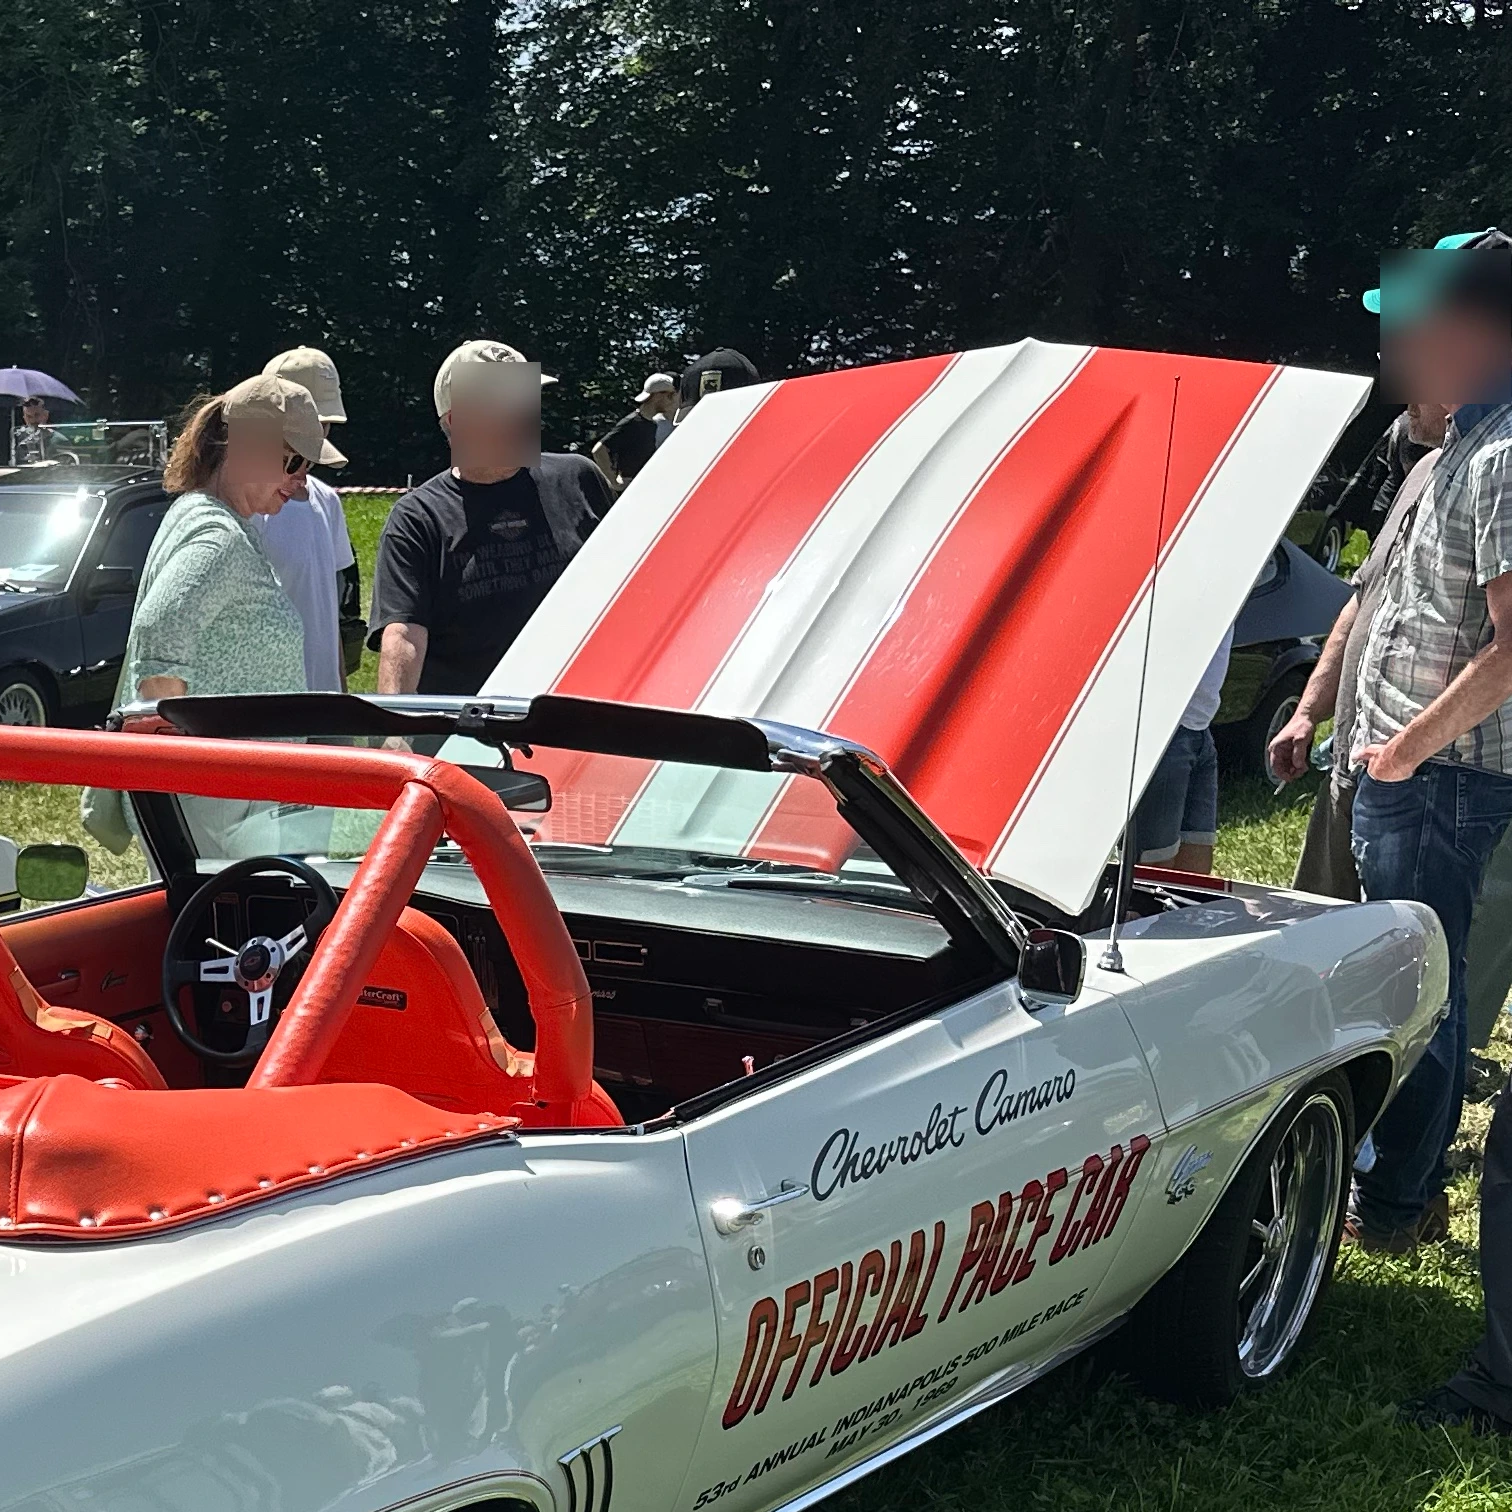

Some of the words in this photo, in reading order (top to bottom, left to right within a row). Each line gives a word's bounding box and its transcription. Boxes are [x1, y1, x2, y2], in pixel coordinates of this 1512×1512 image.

[361, 989, 400, 1001] terCraft
[811, 1103, 968, 1201] Chevrolet
[975, 1069, 1076, 1136] Camaro
[722, 1220, 946, 1431] OFFICIAL
[937, 1167, 1069, 1324] PACE
[1049, 1134, 1151, 1266] CAR
[693, 1474, 742, 1511] 53rd
[743, 1426, 828, 1485] ANNUAL
[831, 1354, 963, 1438] INDIANAPOLIS
[962, 1335, 999, 1367] 500
[999, 1312, 1043, 1347] MILE
[1040, 1287, 1088, 1324] RACE
[825, 1423, 875, 1459] MAY
[912, 1376, 959, 1411] 1969
